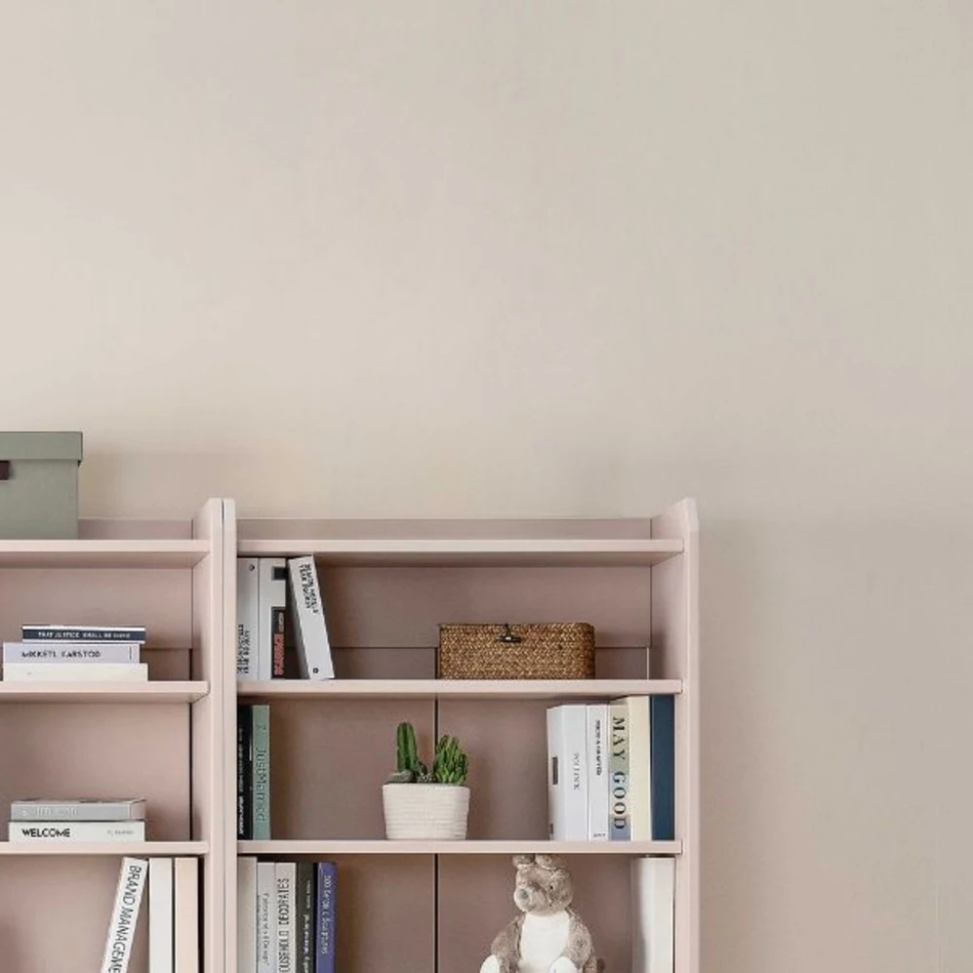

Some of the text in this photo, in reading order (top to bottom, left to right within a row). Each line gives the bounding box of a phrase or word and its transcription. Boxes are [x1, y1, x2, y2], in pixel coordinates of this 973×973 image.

[613, 717, 626, 830] MAY GOOD
[22, 828, 70, 837] WELCOME
[123, 865, 142, 904] BRAND
